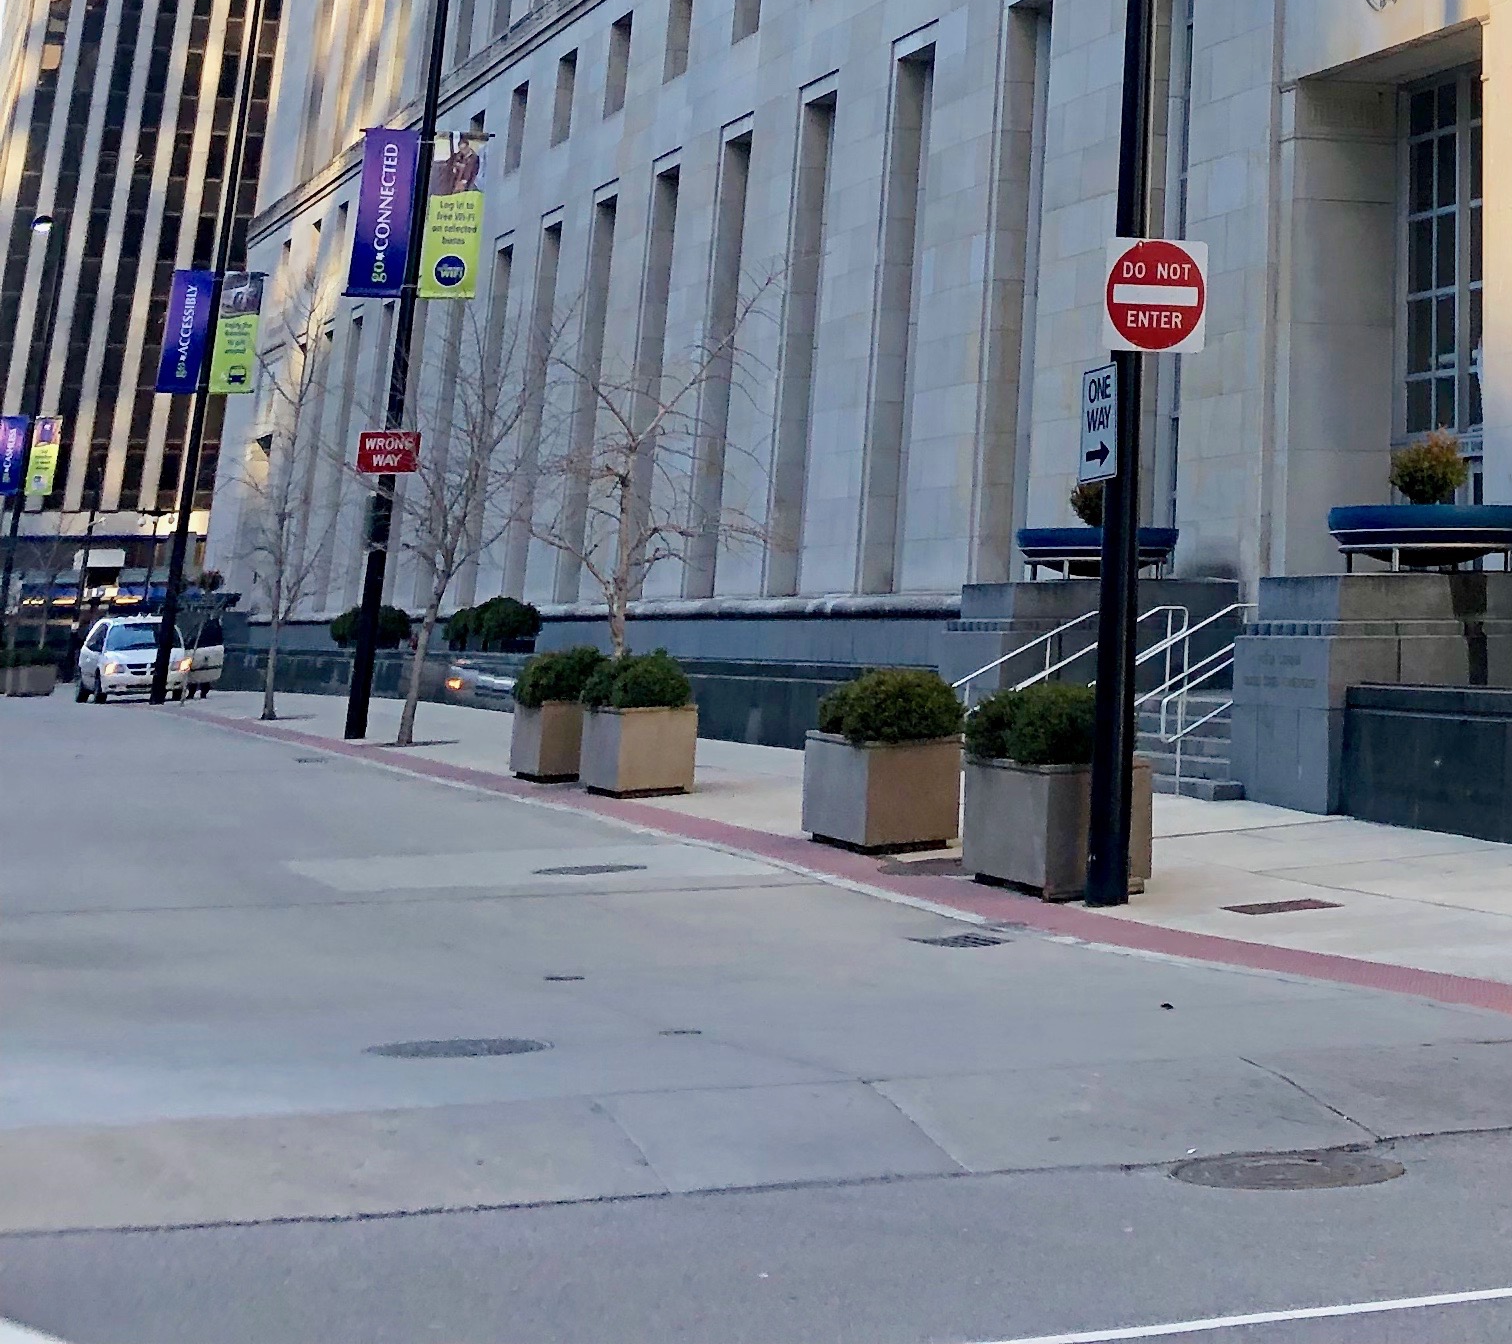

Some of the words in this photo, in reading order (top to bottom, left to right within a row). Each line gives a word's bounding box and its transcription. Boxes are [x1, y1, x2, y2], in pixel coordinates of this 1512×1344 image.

[373, 143, 400, 252] CONNECTED
[440, 201, 454, 211] Log
[466, 202, 475, 210] to
[371, 261, 388, 284] go
[1122, 261, 1146, 278] DO
[1157, 263, 1192, 281] NOT
[177, 284, 199, 356] ACCESSIBLY
[1126, 310, 1183, 330] ENTER
[1088, 374, 1112, 404] ONE
[1086, 405, 1112, 434] WAY
[365, 437, 415, 451] WRONG
[372, 454, 403, 467] WAY
